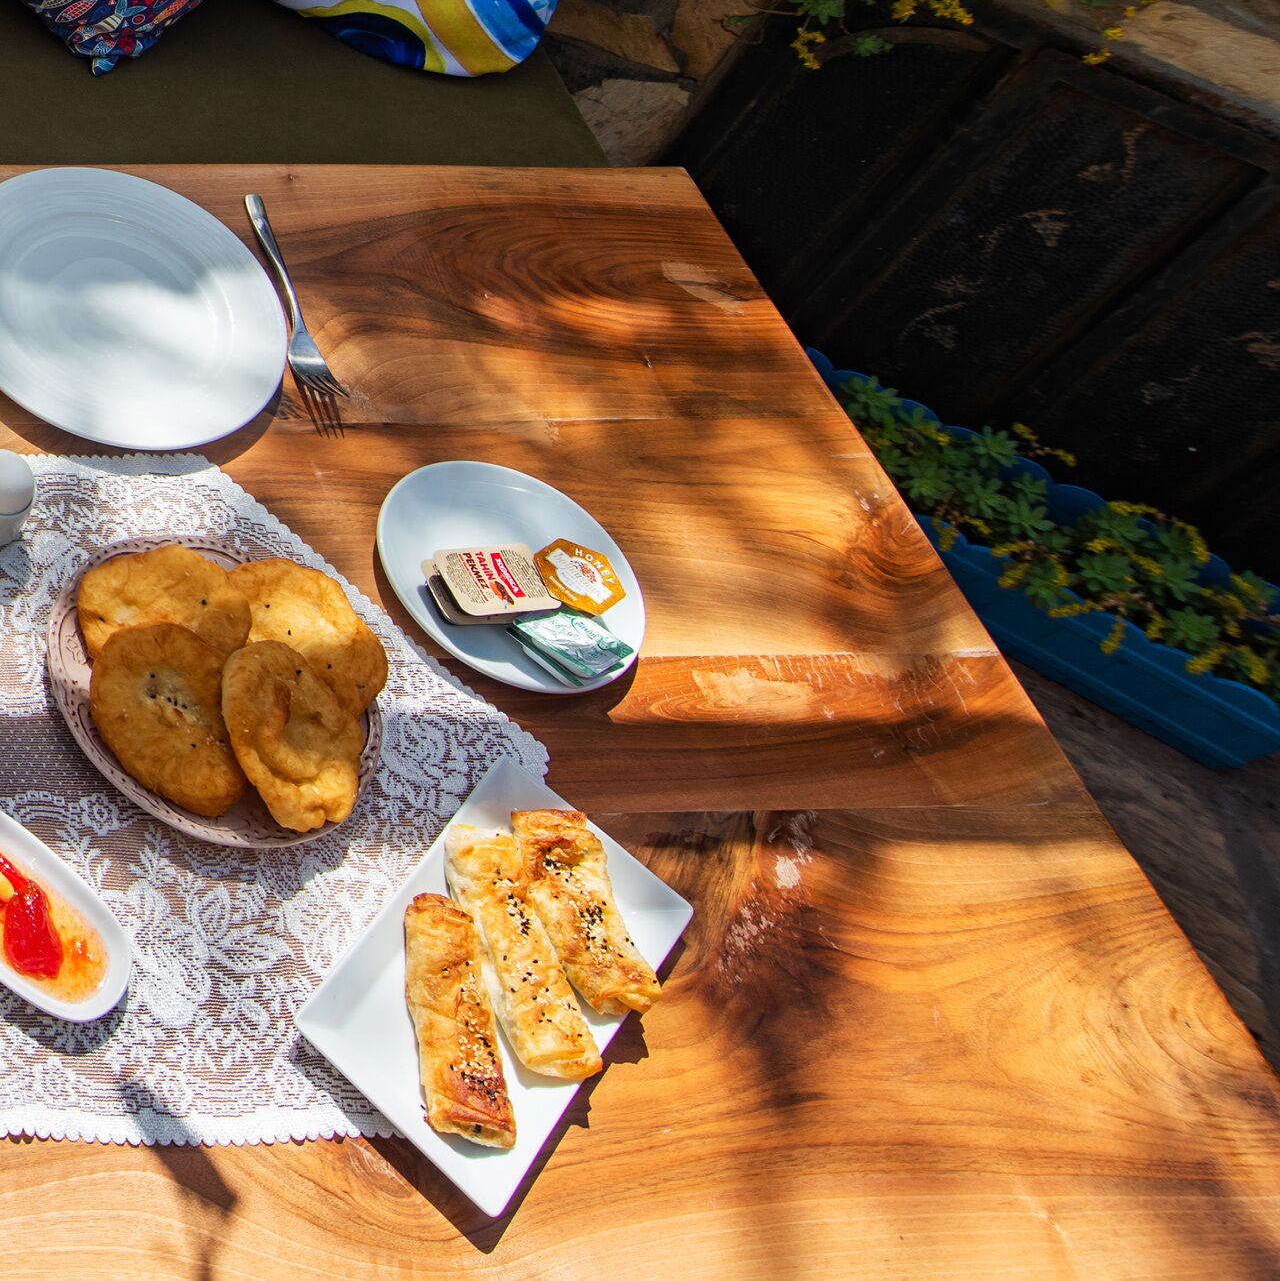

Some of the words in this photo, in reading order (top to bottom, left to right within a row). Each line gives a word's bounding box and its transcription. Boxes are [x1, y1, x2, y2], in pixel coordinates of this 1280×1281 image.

[462, 552, 490, 589] PEKMEZ
[475, 551, 496, 581] TAHİN
[575, 548, 616, 584] HONEY
